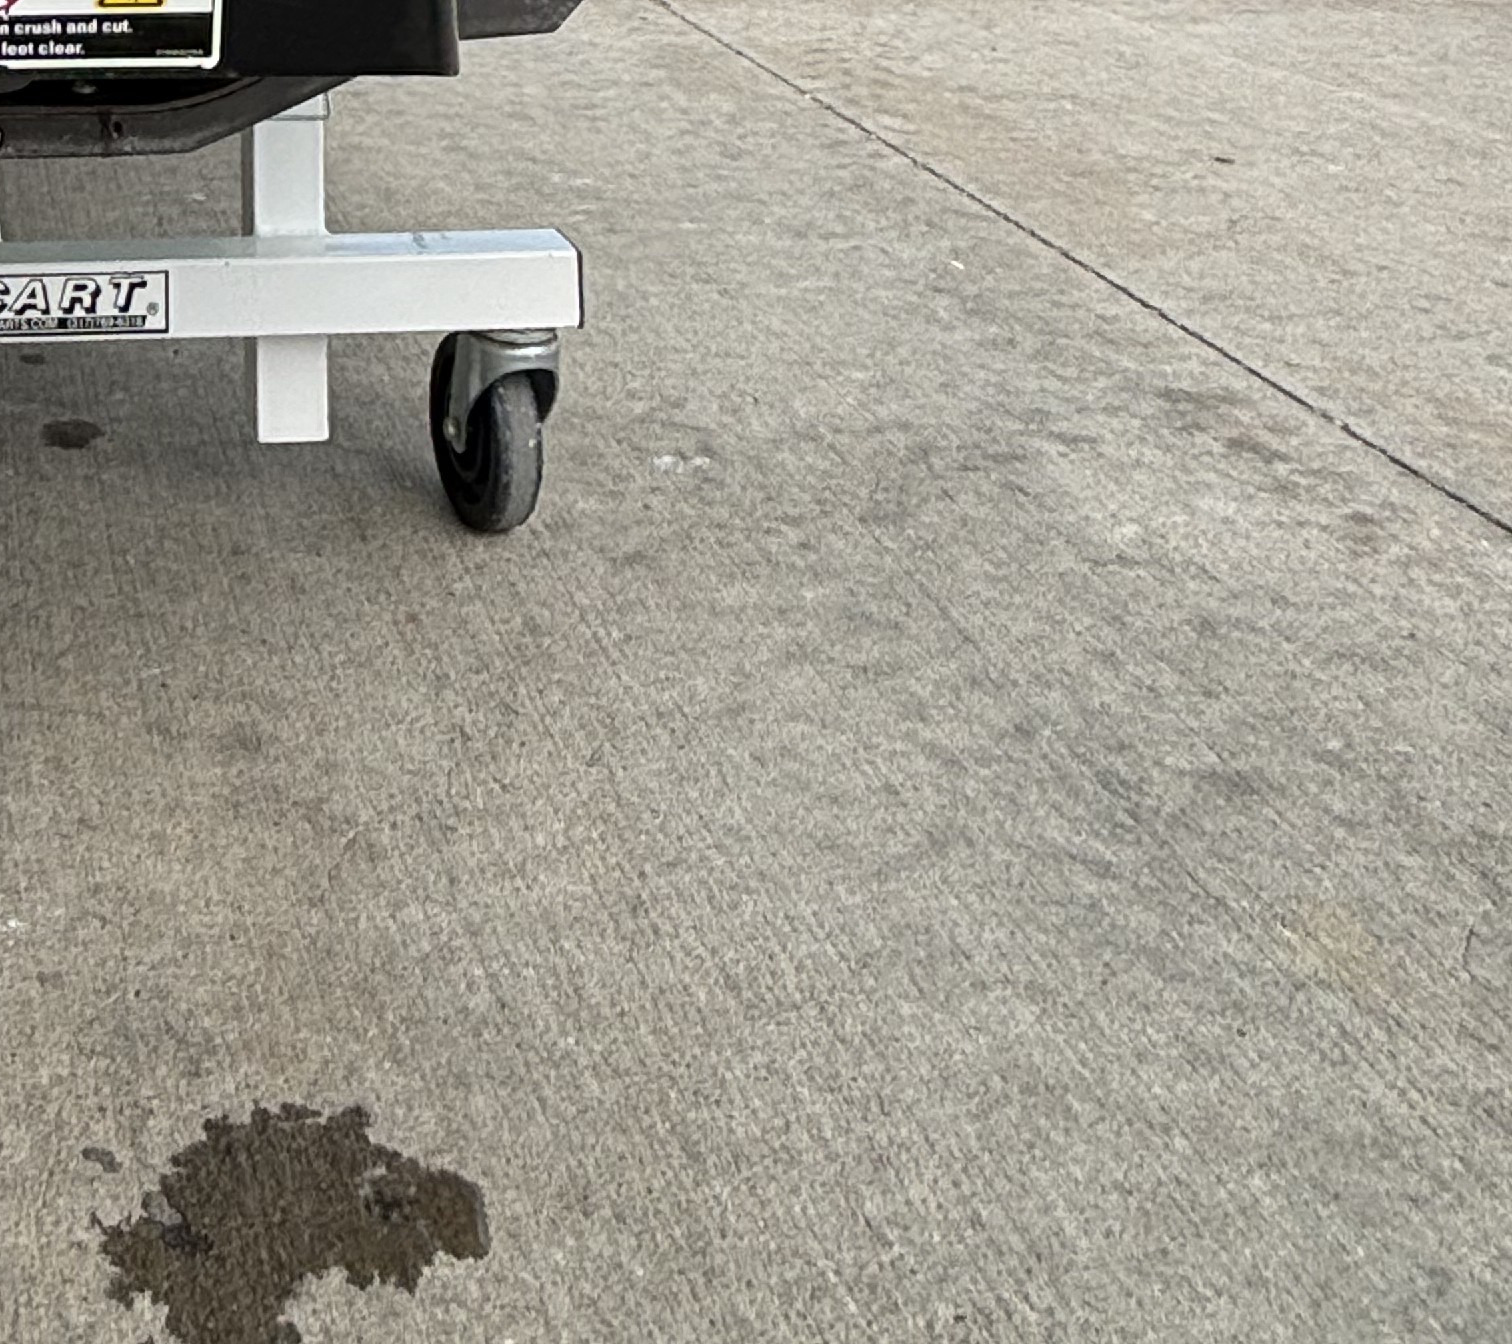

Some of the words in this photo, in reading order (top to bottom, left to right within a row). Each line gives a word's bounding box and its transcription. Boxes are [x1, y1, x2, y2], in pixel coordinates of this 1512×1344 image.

[14, 19, 62, 35] crush
[66, 19, 98, 34] and
[102, 19, 134, 34] cut.
[38, 40, 86, 56] clear.
